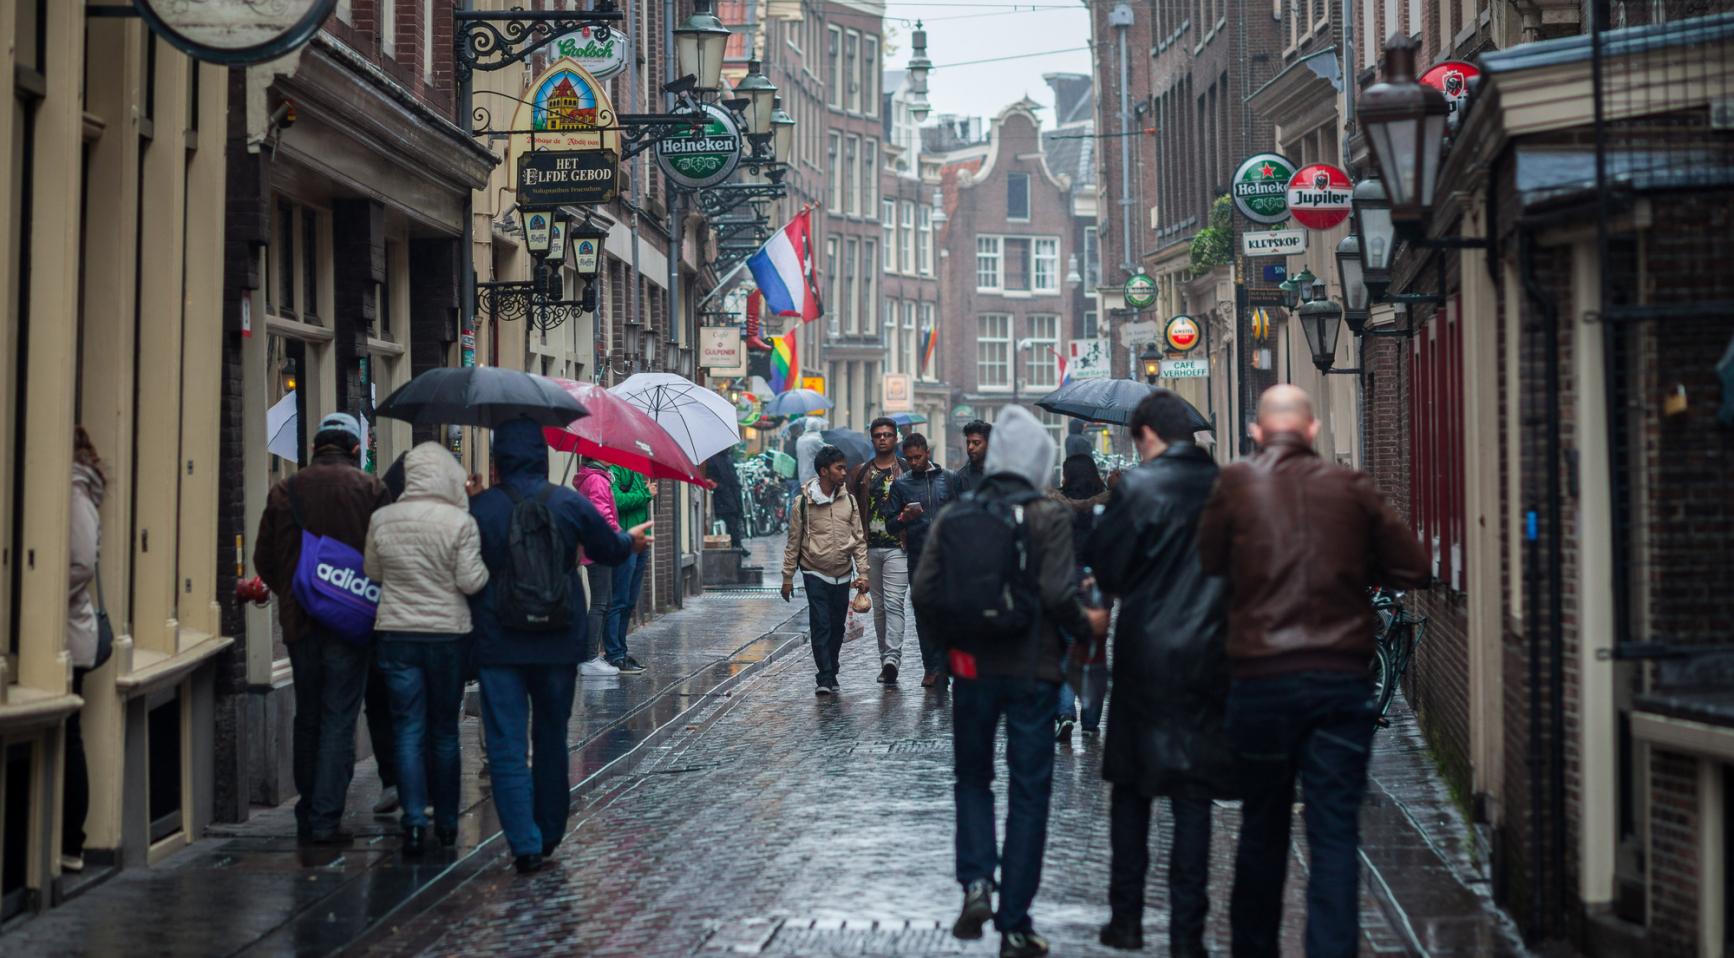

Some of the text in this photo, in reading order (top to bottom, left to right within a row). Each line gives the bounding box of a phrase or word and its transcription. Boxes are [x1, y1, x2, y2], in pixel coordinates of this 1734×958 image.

[558, 38, 615, 59] Grolsch
[662, 138, 734, 153] Heineken
[556, 158, 579, 170] HET
[524, 168, 612, 186] ELFDE GEBOD
[1238, 181, 1288, 196] Heinek
[1294, 190, 1349, 208] Jupiler
[1248, 237, 1300, 249] KLETSKOP
[1163, 369, 1207, 377] VERHOEFF
[317, 563, 381, 603] adida
